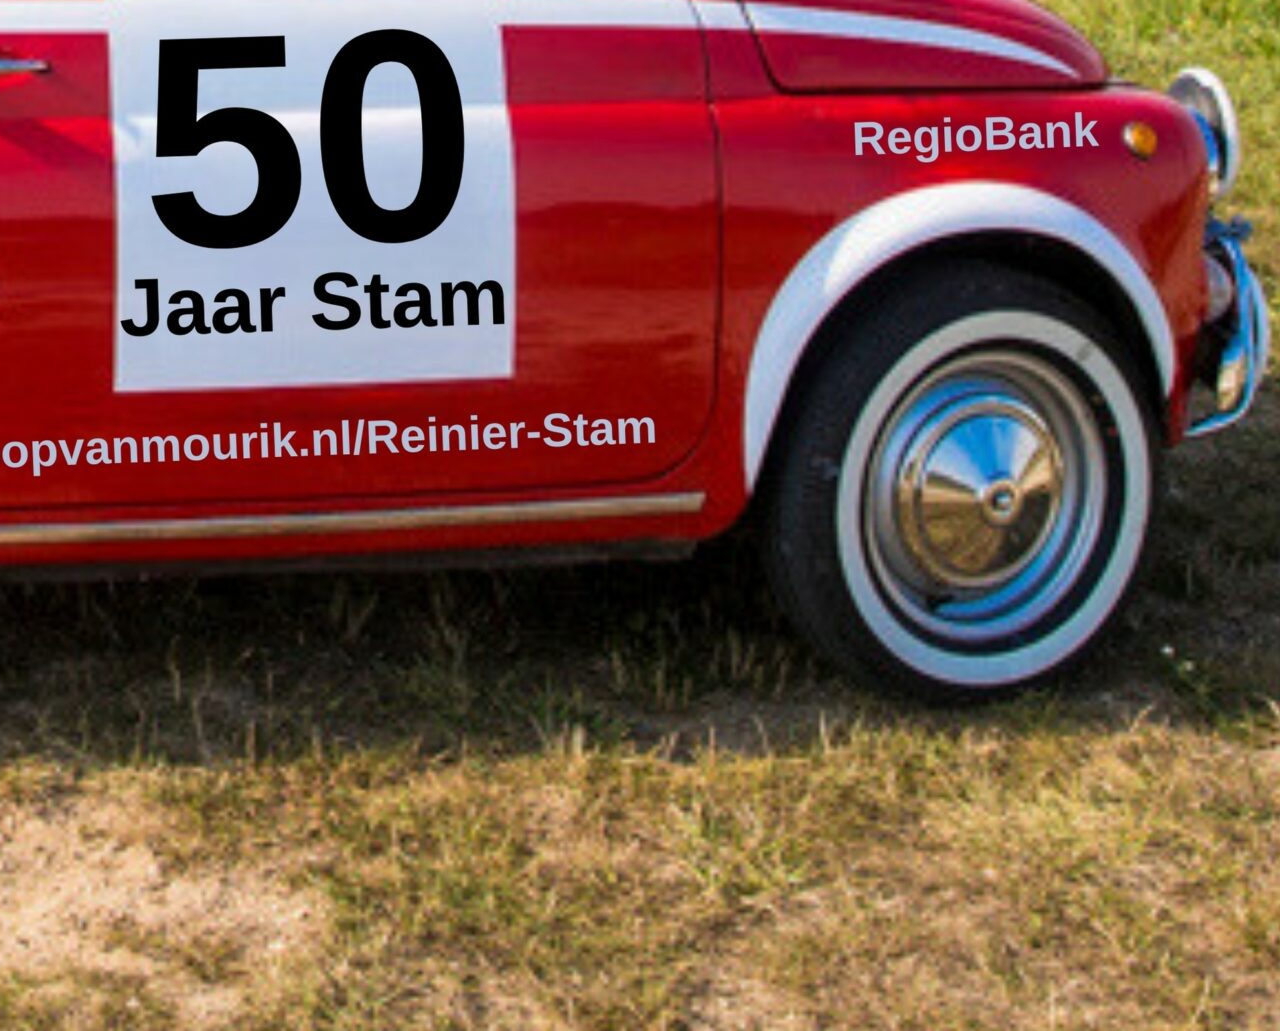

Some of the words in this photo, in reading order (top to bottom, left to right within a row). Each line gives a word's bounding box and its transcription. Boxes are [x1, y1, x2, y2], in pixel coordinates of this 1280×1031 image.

[151, 28, 465, 249] 50
[853, 111, 1100, 163] RegioBank
[120, 278, 286, 337] Jaar
[311, 271, 505, 330] Stam
